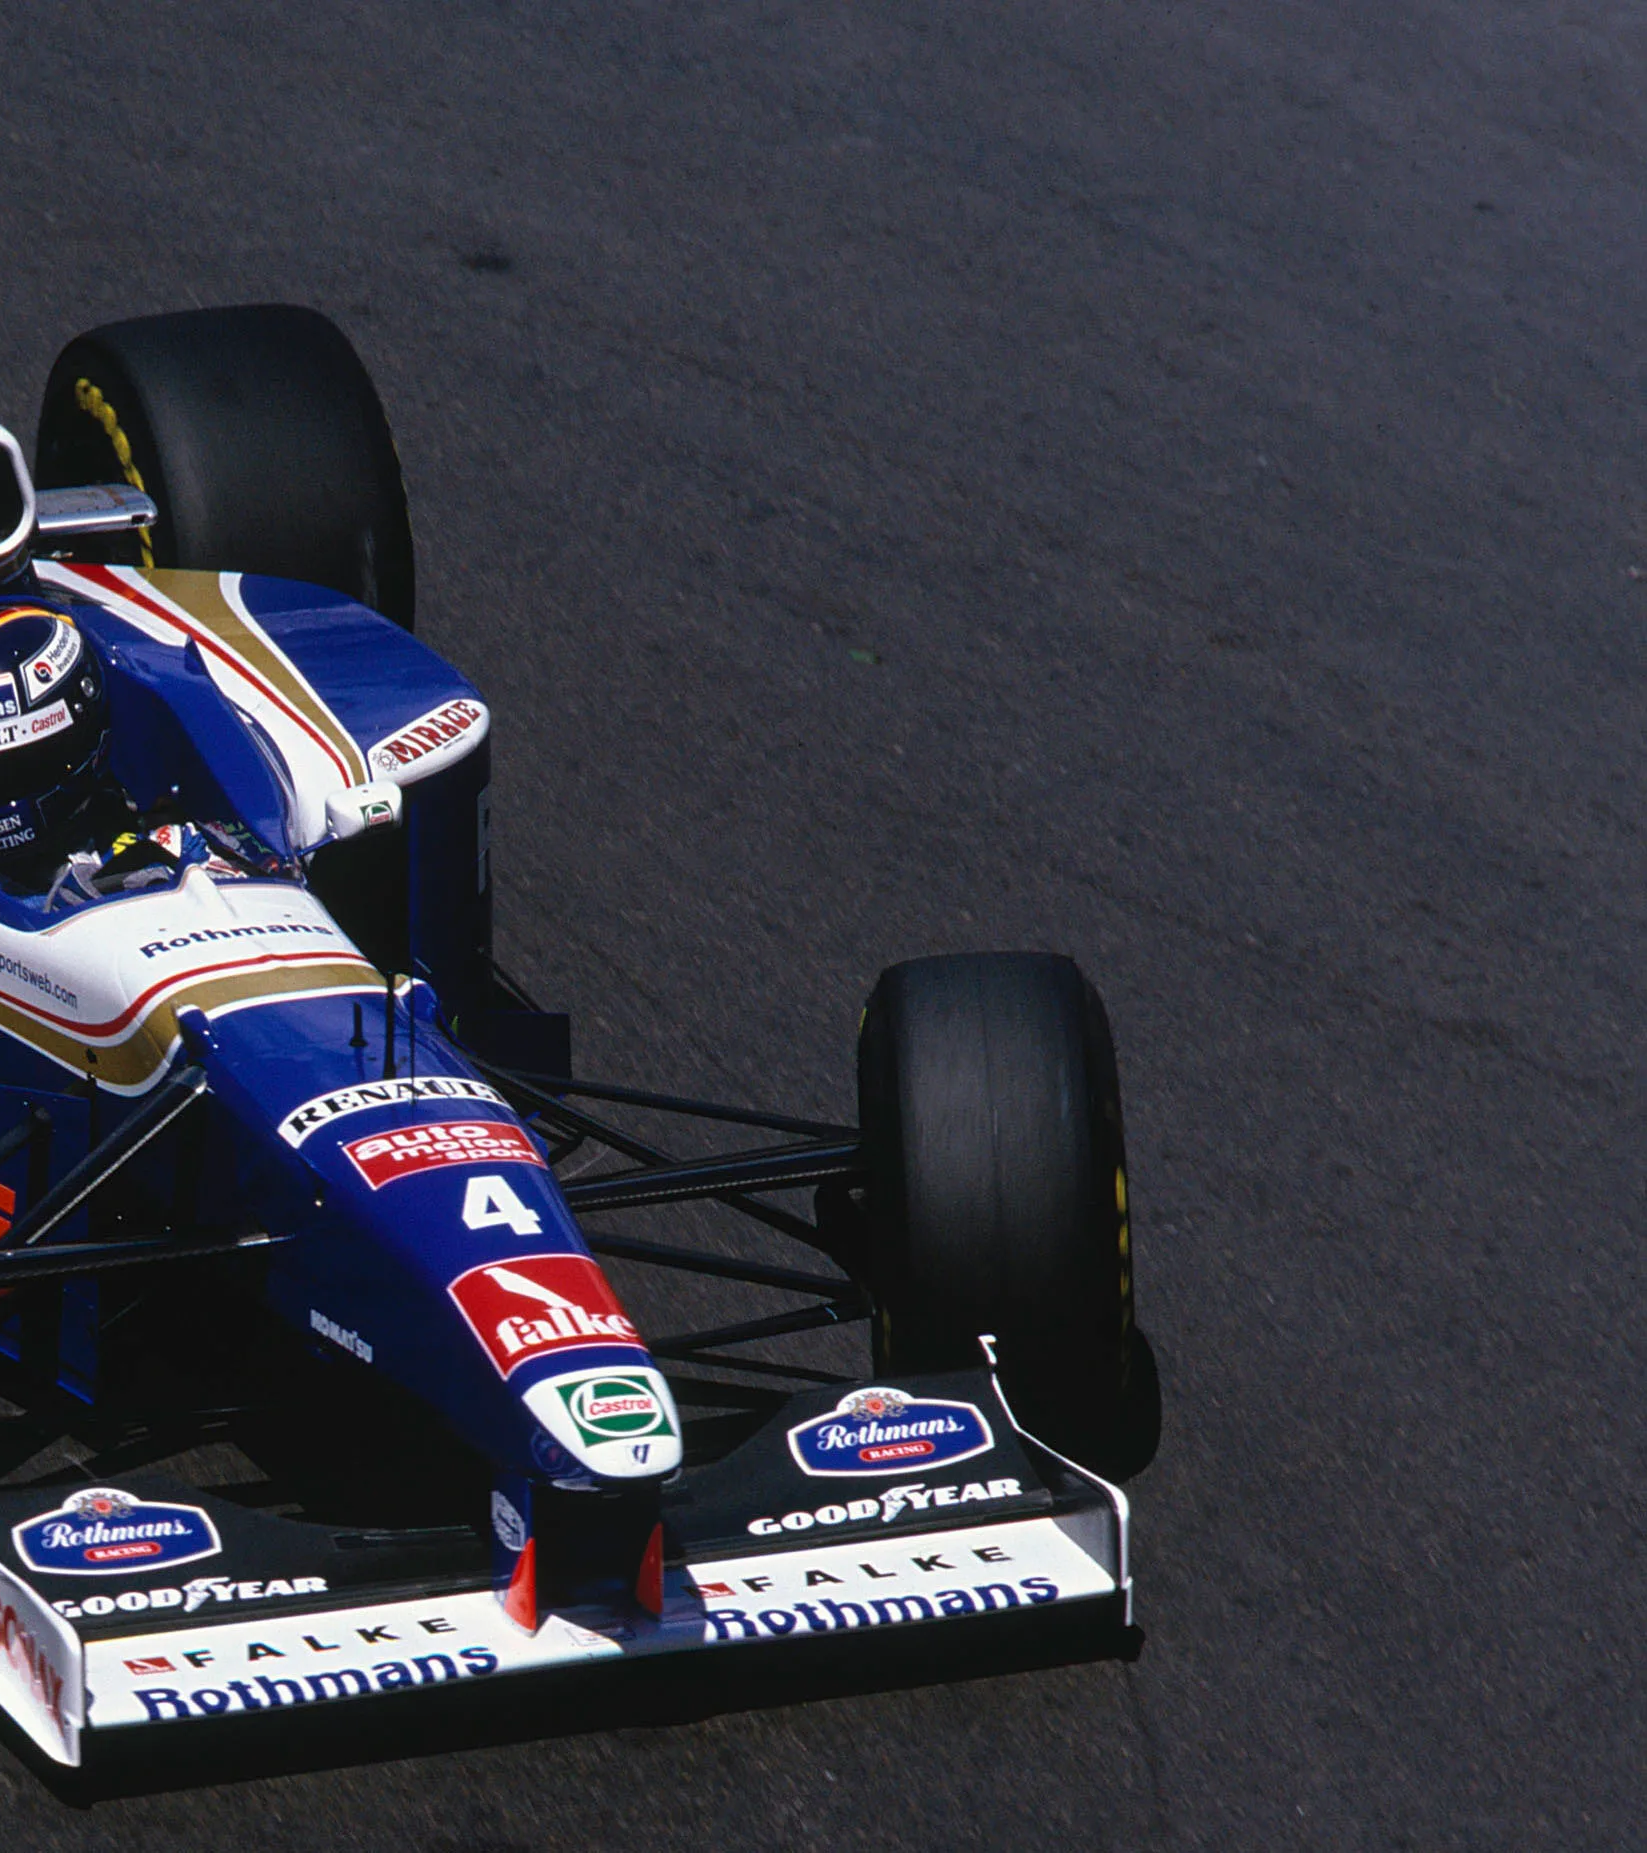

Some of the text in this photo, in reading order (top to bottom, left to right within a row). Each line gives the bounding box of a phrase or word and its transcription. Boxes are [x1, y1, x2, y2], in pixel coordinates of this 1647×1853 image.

[32, 708, 66, 735] Castrol
[384, 700, 481, 764] MIRAGE
[140, 923, 334, 959] Rothmans
[355, 1125, 489, 1161] auto
[391, 1138, 521, 1162] motor
[462, 1175, 543, 1236] 4
[496, 1305, 639, 1357] falke
[589, 1398, 653, 1416] Castrol
[817, 1415, 966, 1451] Rothmans
[871, 1444, 926, 1460] RACING
[748, 1478, 1023, 1536] GOODYEAR
[41, 1518, 193, 1549] Rothmans
[742, 1546, 1016, 1593] FALKE
[705, 1576, 1060, 1641] Rothmans
[183, 1617, 457, 1668] FALKE
[133, 1646, 499, 1721] Rothmans
